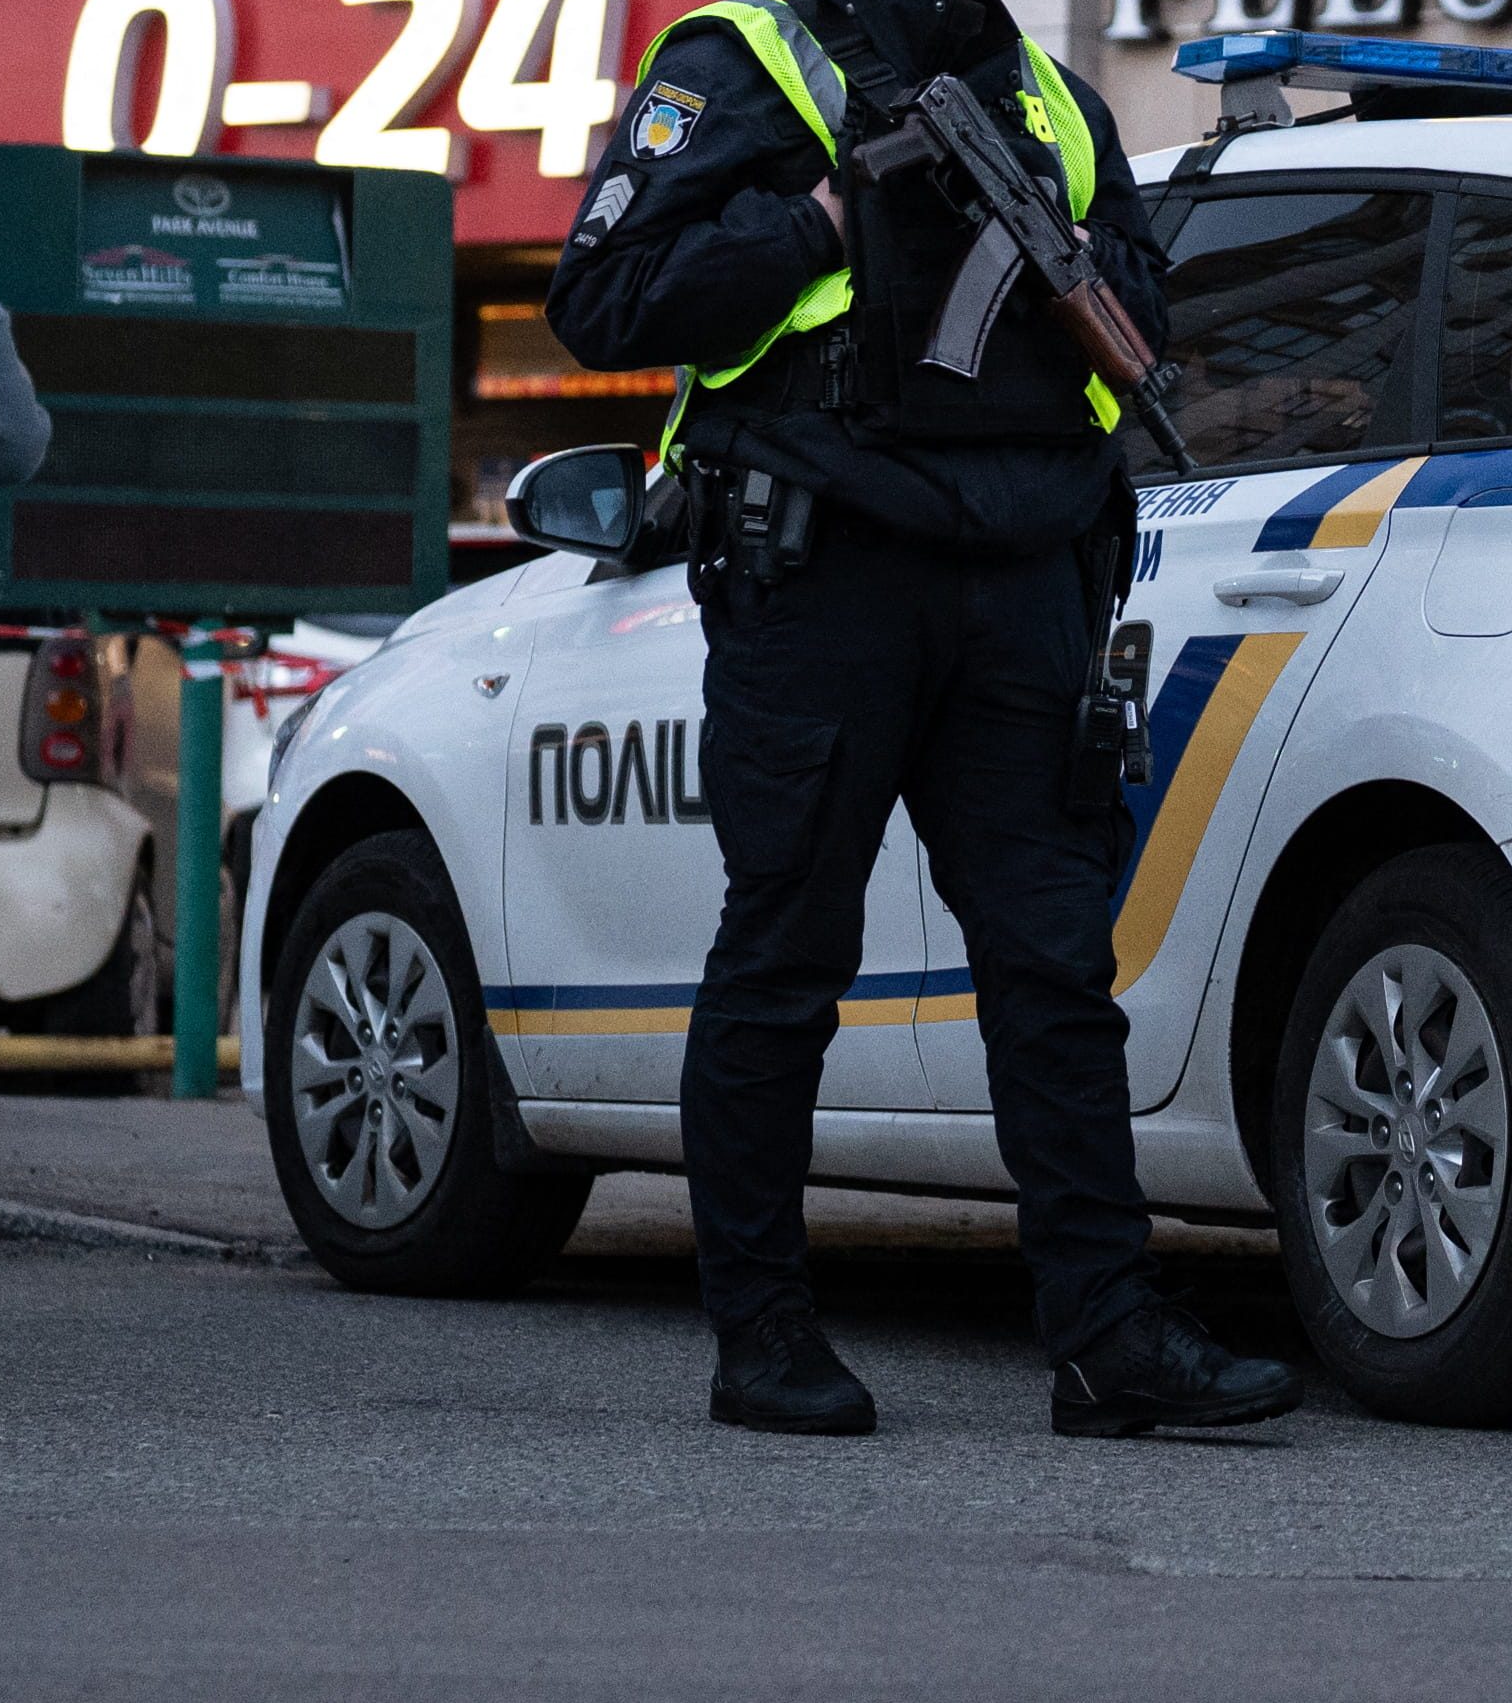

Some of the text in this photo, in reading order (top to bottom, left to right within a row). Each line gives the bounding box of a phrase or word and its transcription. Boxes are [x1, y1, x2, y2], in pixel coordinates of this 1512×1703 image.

[151, 214, 259, 240] PARK AVENUE
[528, 719, 713, 826] ПОЛІЦ
